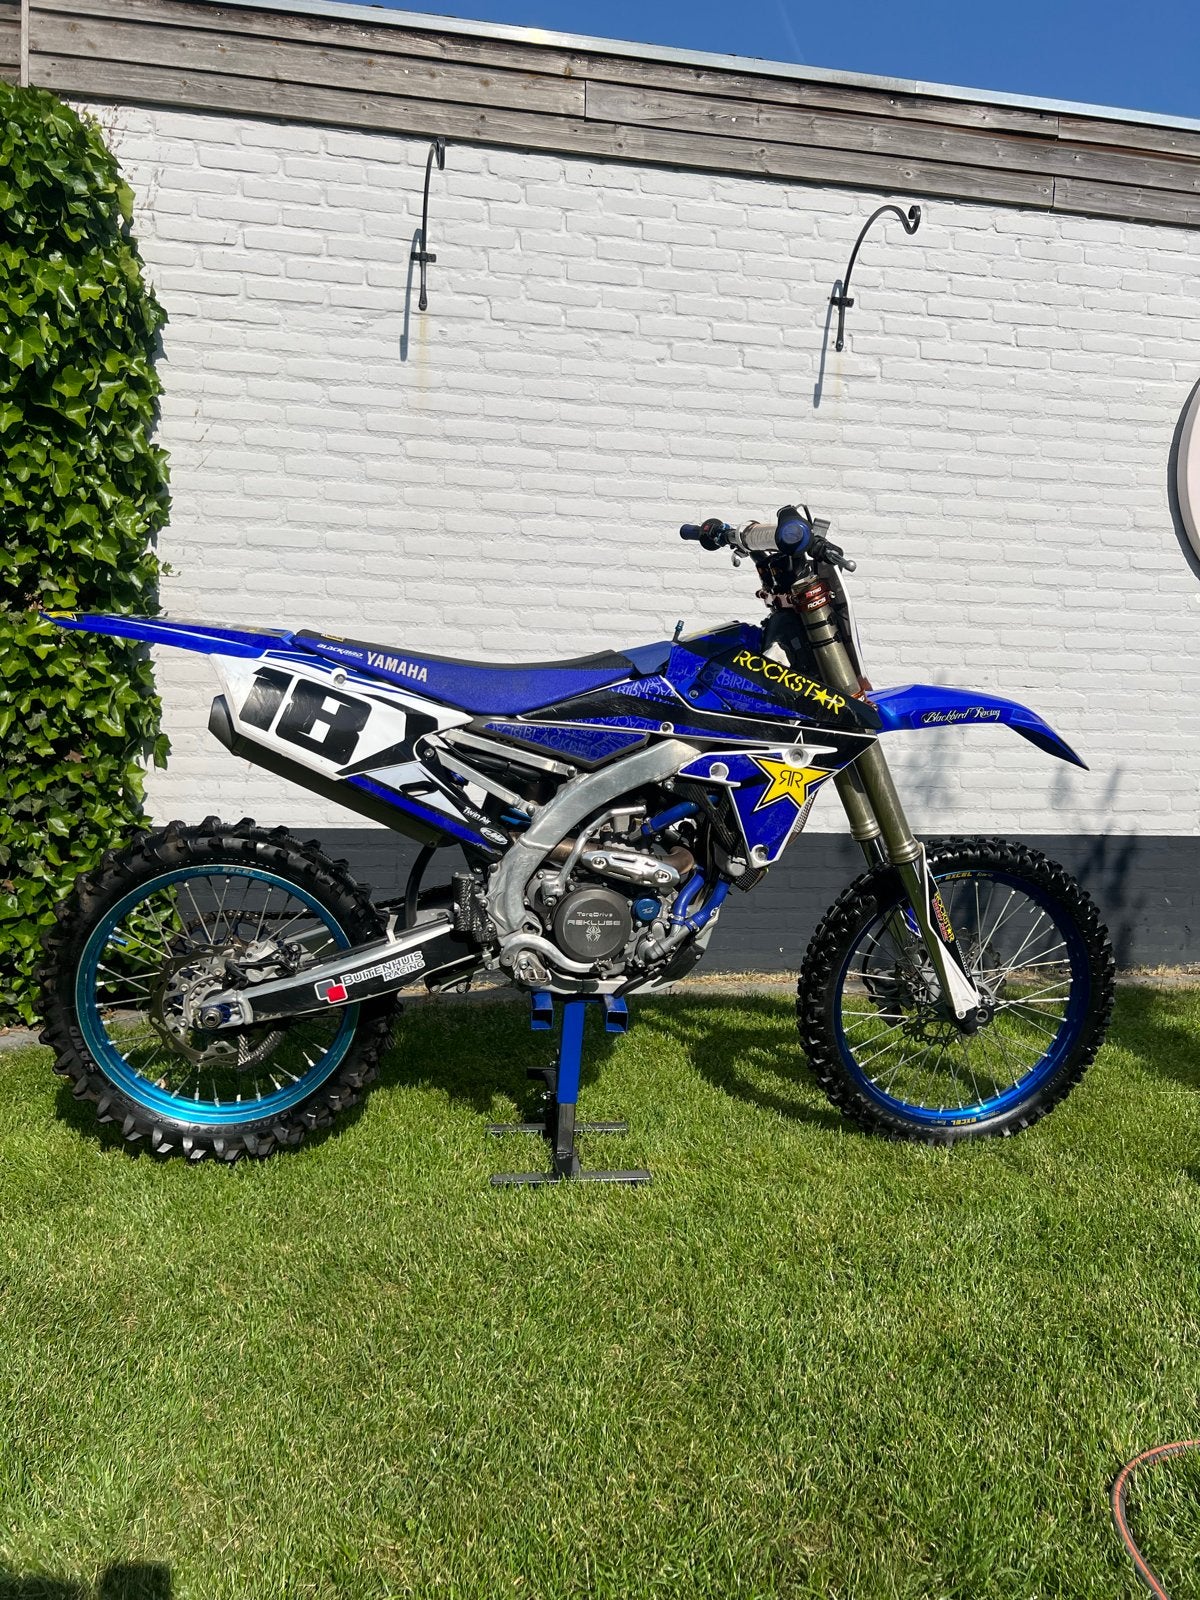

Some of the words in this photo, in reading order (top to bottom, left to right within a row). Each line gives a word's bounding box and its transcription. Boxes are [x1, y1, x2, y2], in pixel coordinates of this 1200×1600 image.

[367, 651, 428, 682] YAMAHA
[733, 650, 846, 715] ROCKSTAR
[239, 666, 372, 765] 18
[921, 708, 970, 724] Blackbird
[970, 706, 1001, 721] Racing
[463, 806, 480, 820] Twin
[480, 816, 492, 825] Air
[945, 872, 973, 880] EXCEL
[341, 951, 424, 986] BUITENHUIS
[383, 960, 426, 982] RACING
[951, 1117, 977, 1126] EXCEL
